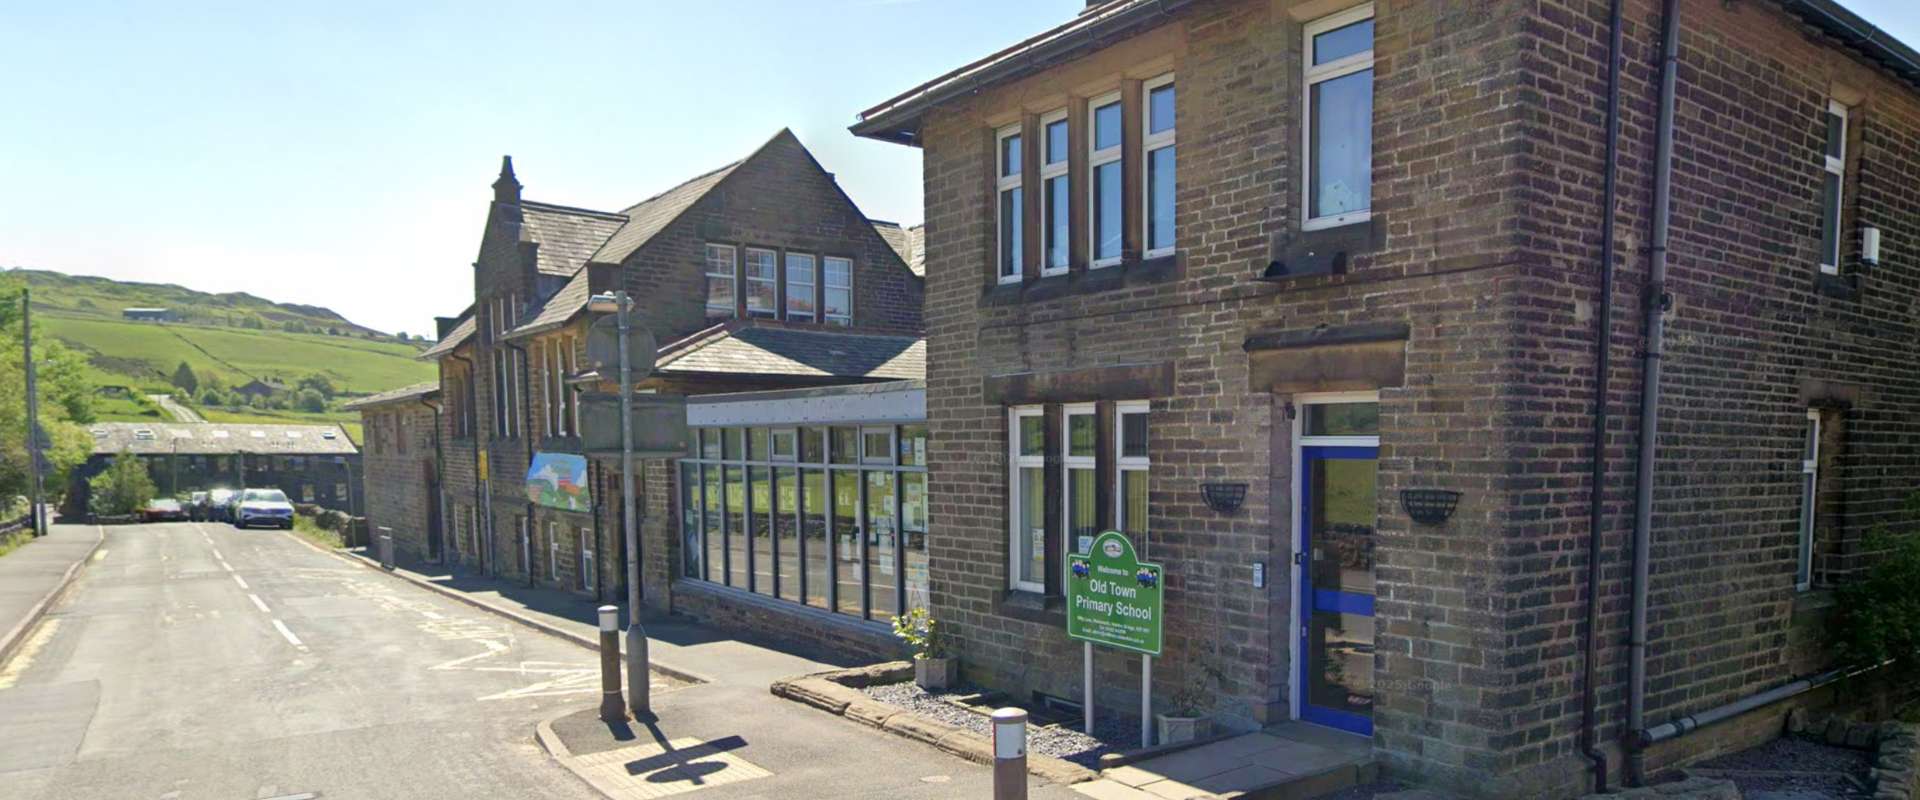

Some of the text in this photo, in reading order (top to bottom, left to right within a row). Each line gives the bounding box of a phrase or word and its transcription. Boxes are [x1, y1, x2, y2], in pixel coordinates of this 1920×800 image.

[1090, 579, 1137, 599] Old Town
[1076, 595, 1152, 621] Primary School
